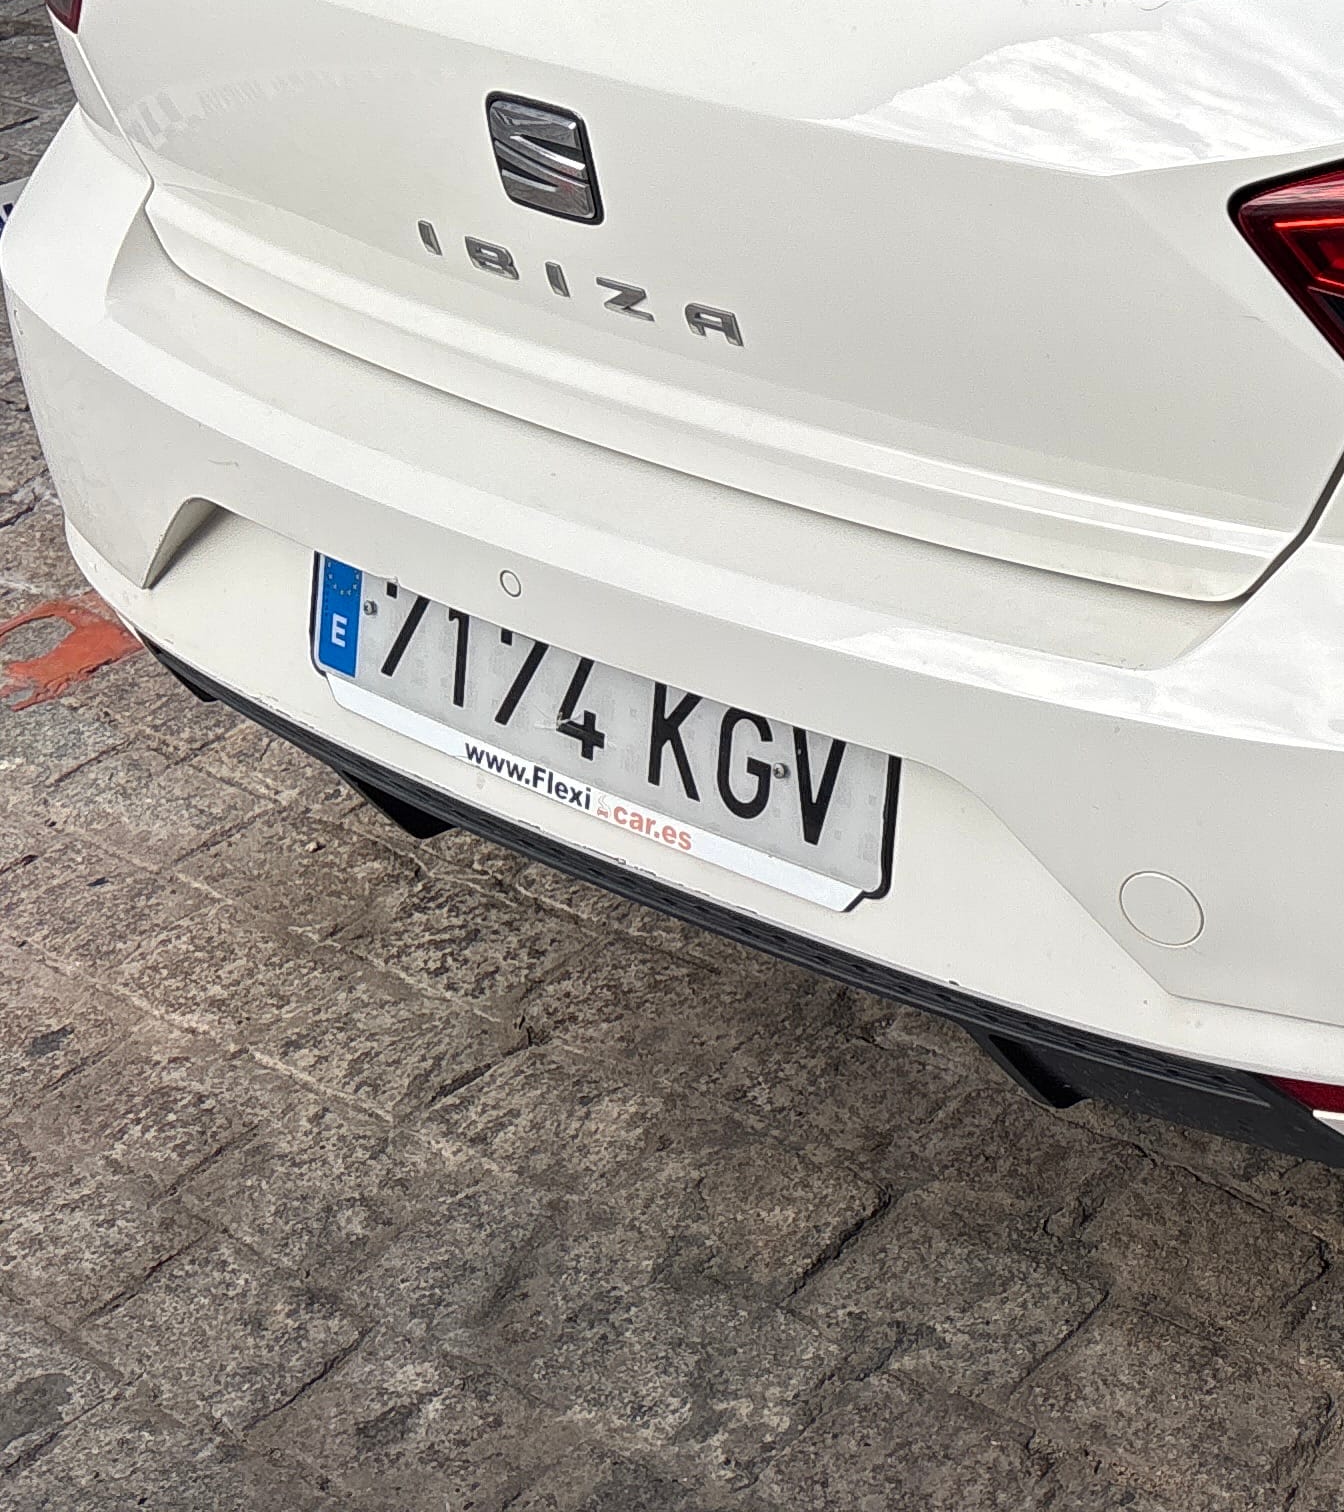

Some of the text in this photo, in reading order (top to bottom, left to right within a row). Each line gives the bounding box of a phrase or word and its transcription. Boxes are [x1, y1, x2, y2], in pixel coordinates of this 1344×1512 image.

[417, 219, 746, 348] IBIZA
[331, 612, 348, 649] E
[381, 581, 846, 846] 7174 KGV
